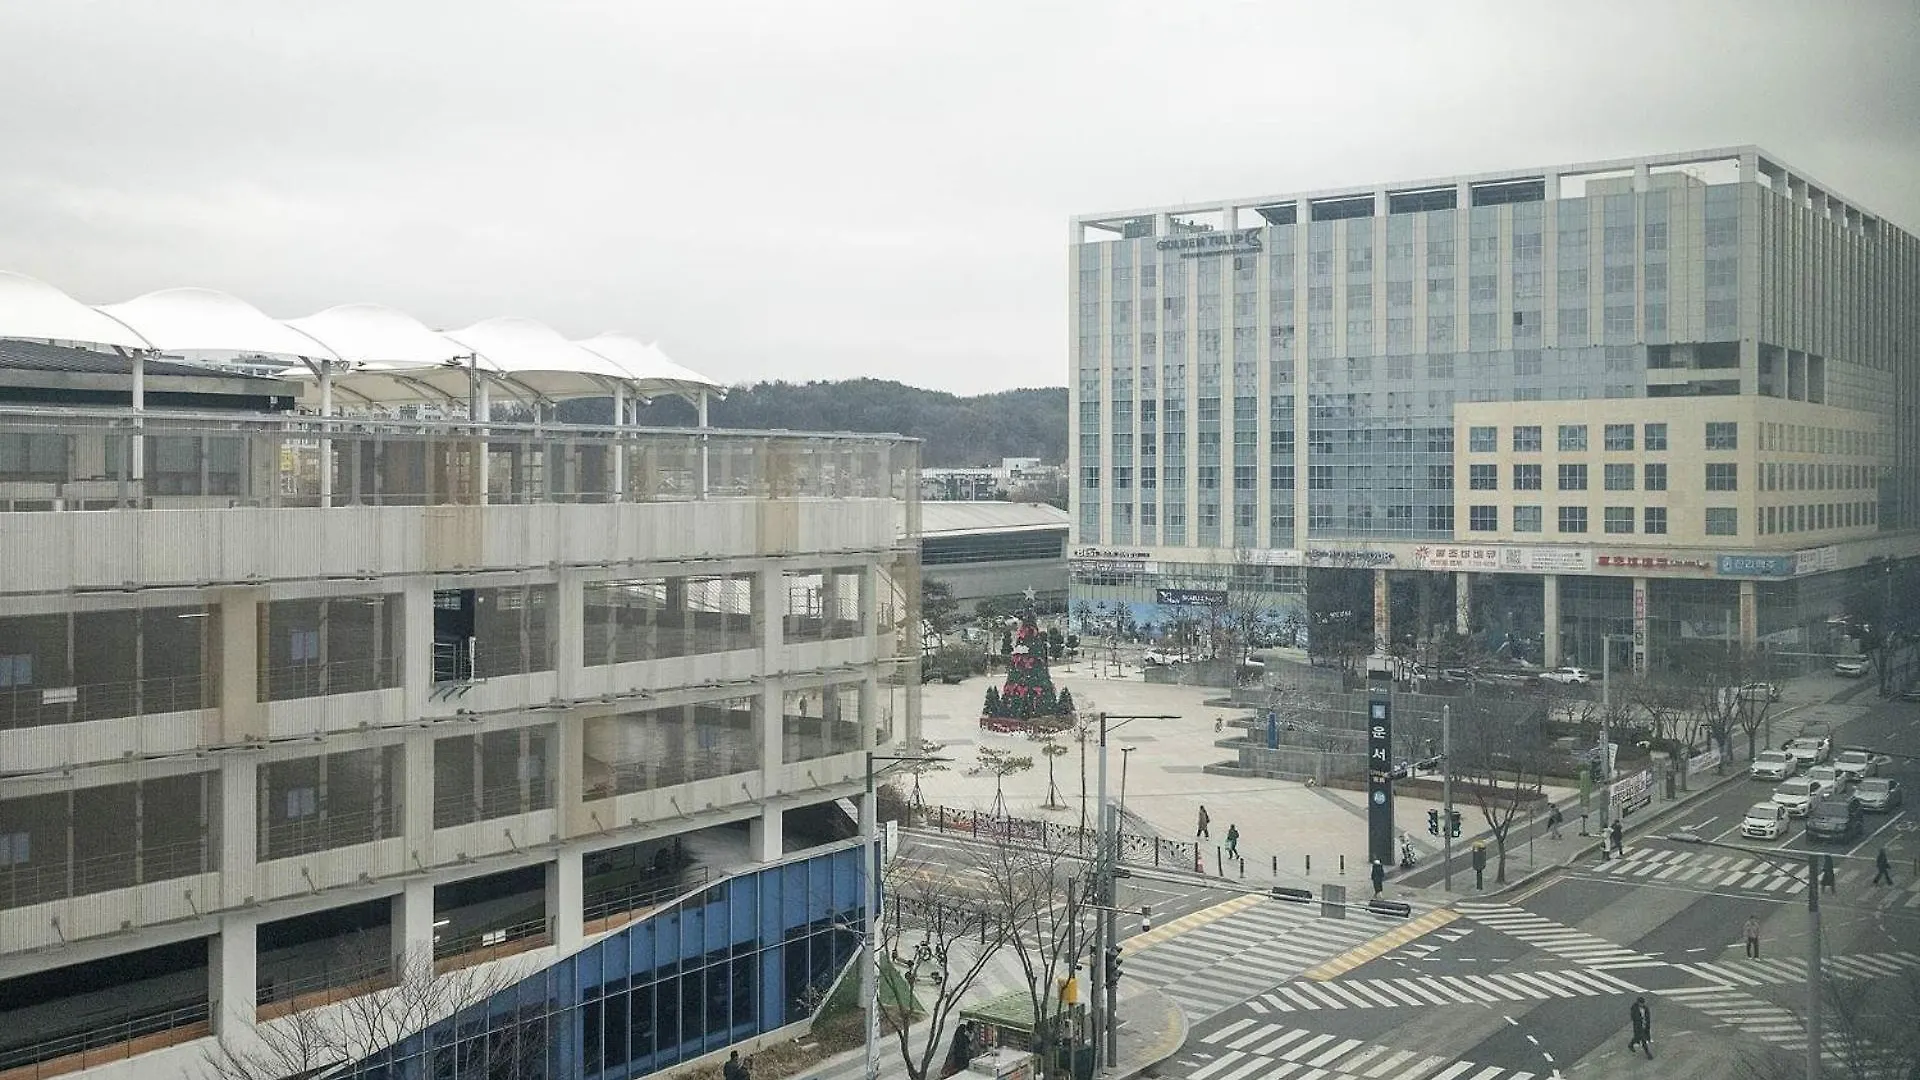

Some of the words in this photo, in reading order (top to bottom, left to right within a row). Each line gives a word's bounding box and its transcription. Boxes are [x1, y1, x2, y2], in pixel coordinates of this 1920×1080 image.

[1157, 237, 1206, 250] GOLDEN
[1208, 234, 1243, 247] TULIP
[1372, 726, 1386, 761] 운서
